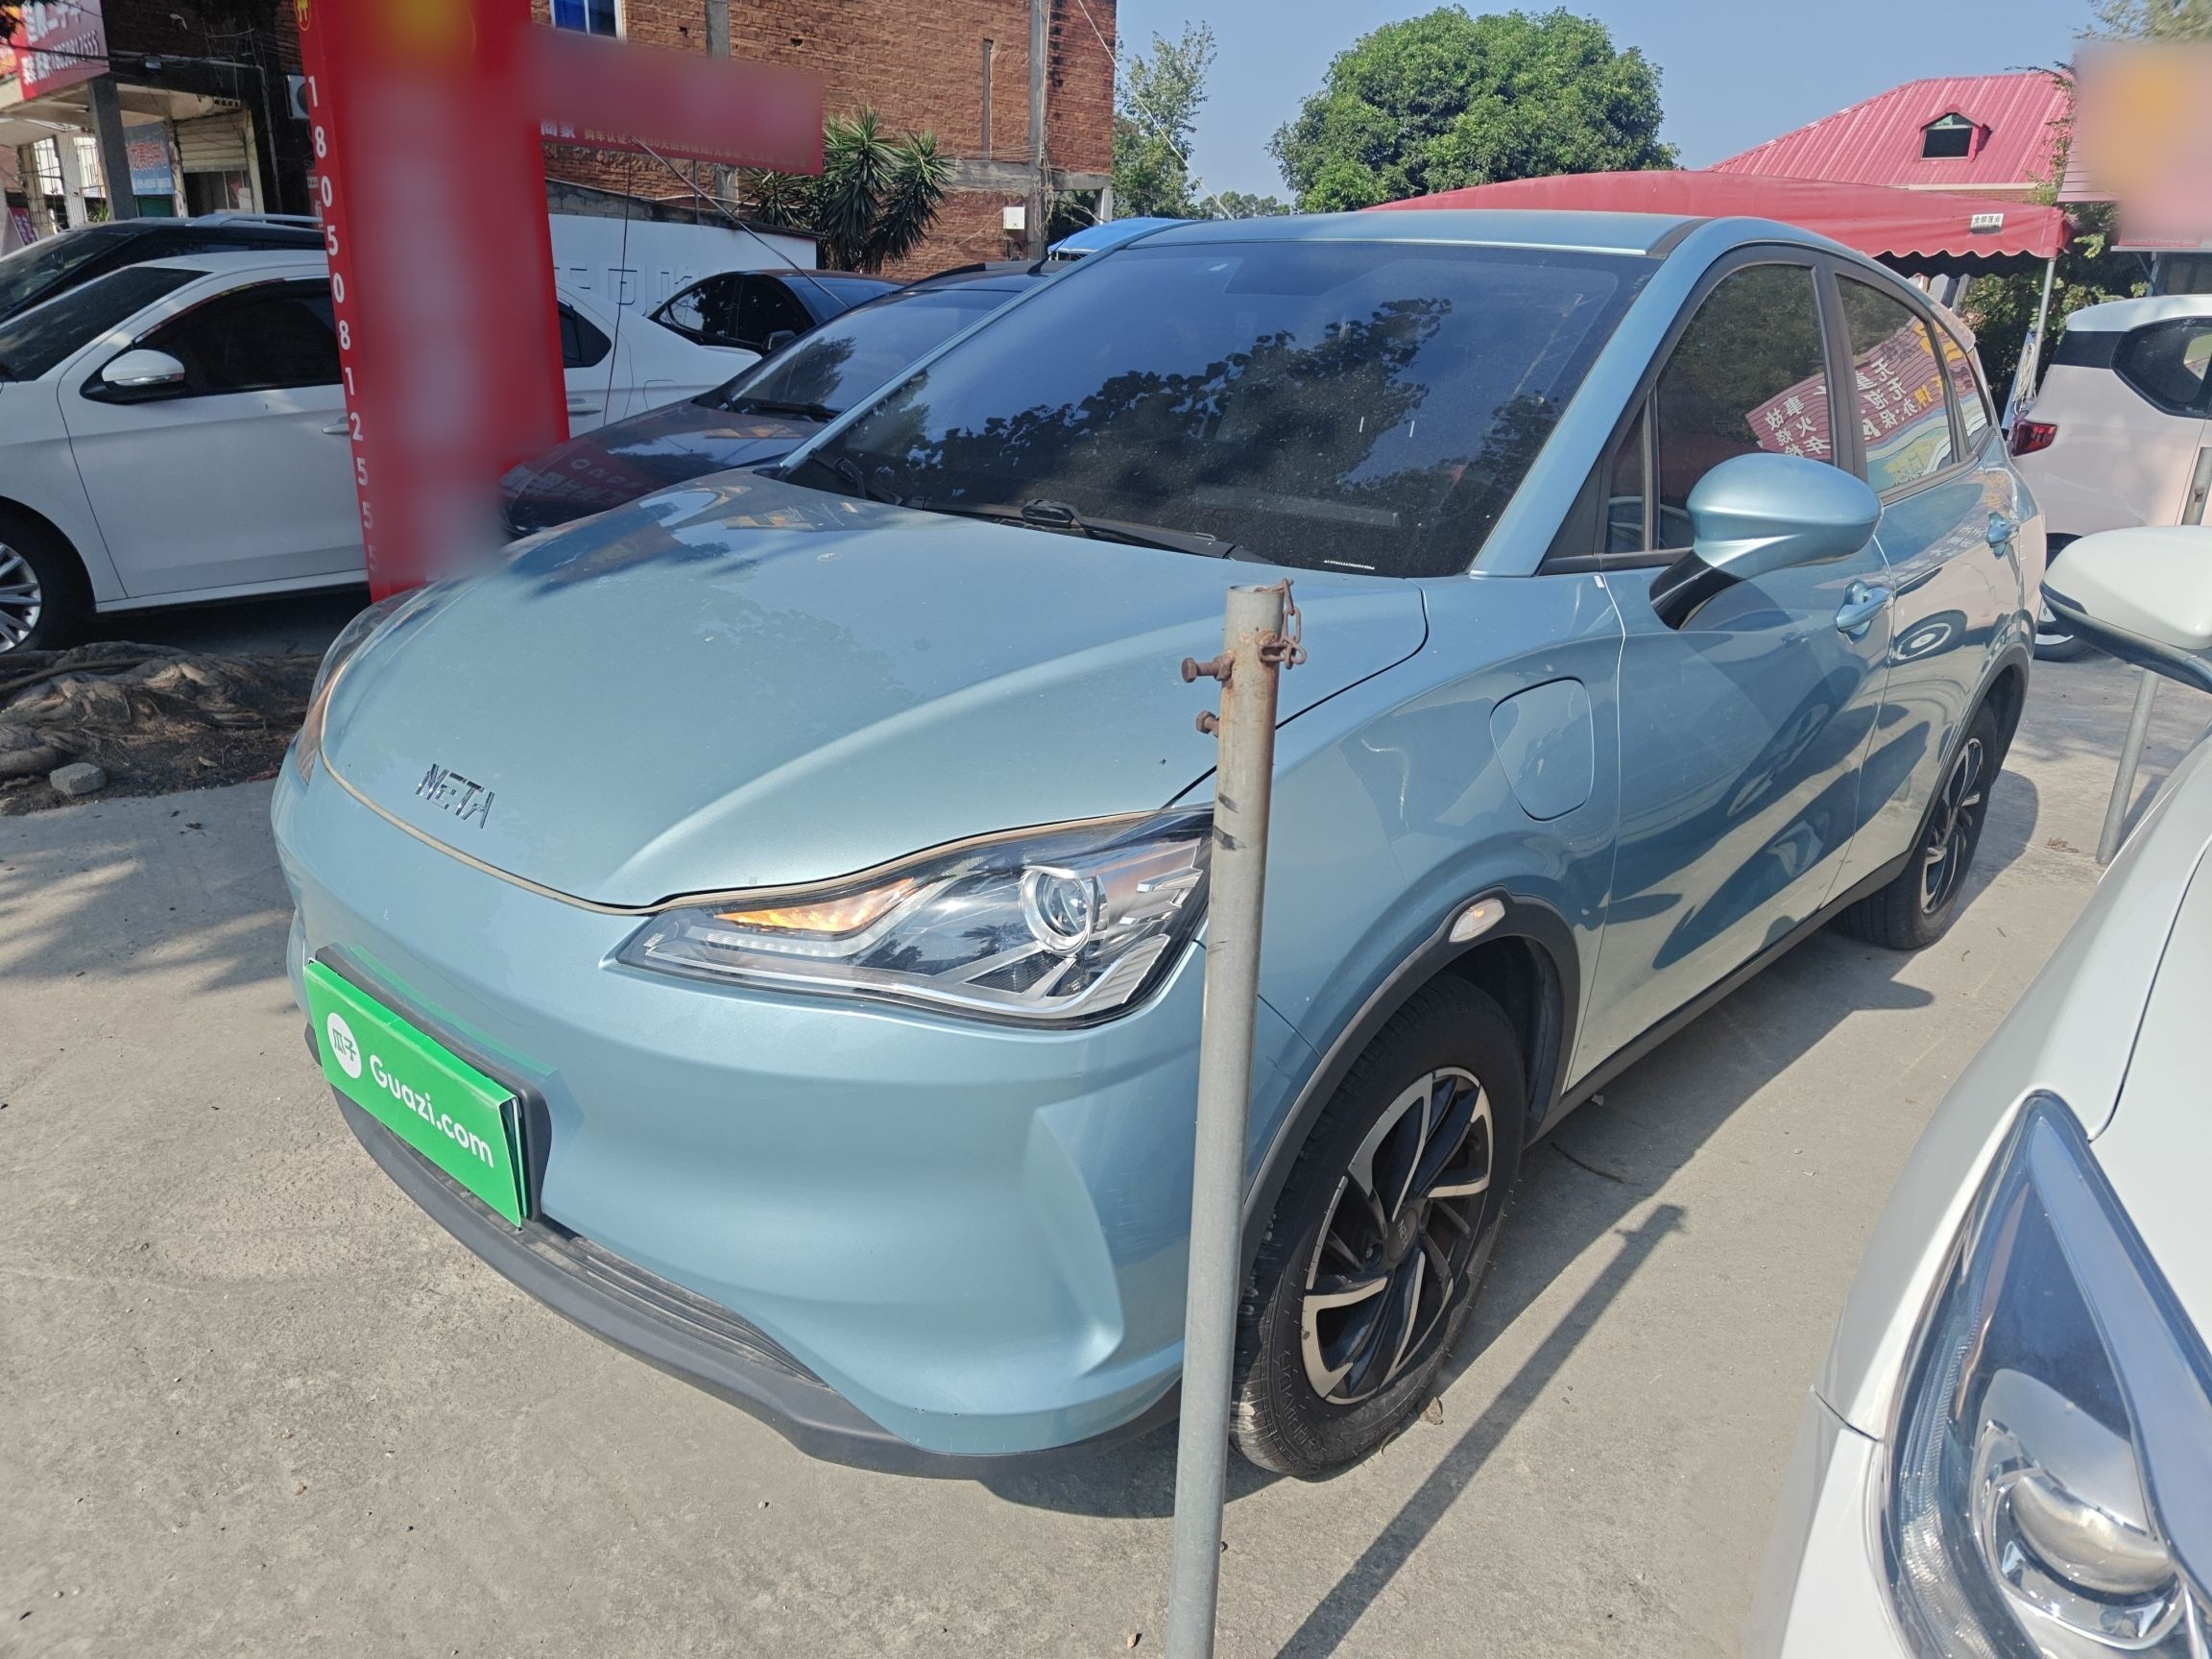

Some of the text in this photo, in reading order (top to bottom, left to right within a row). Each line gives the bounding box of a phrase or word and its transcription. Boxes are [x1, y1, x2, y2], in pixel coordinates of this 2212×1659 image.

[416, 763, 495, 830] NETA
[331, 1028, 357, 1063] 瓜子
[369, 1053, 494, 1168] Guazi.com
